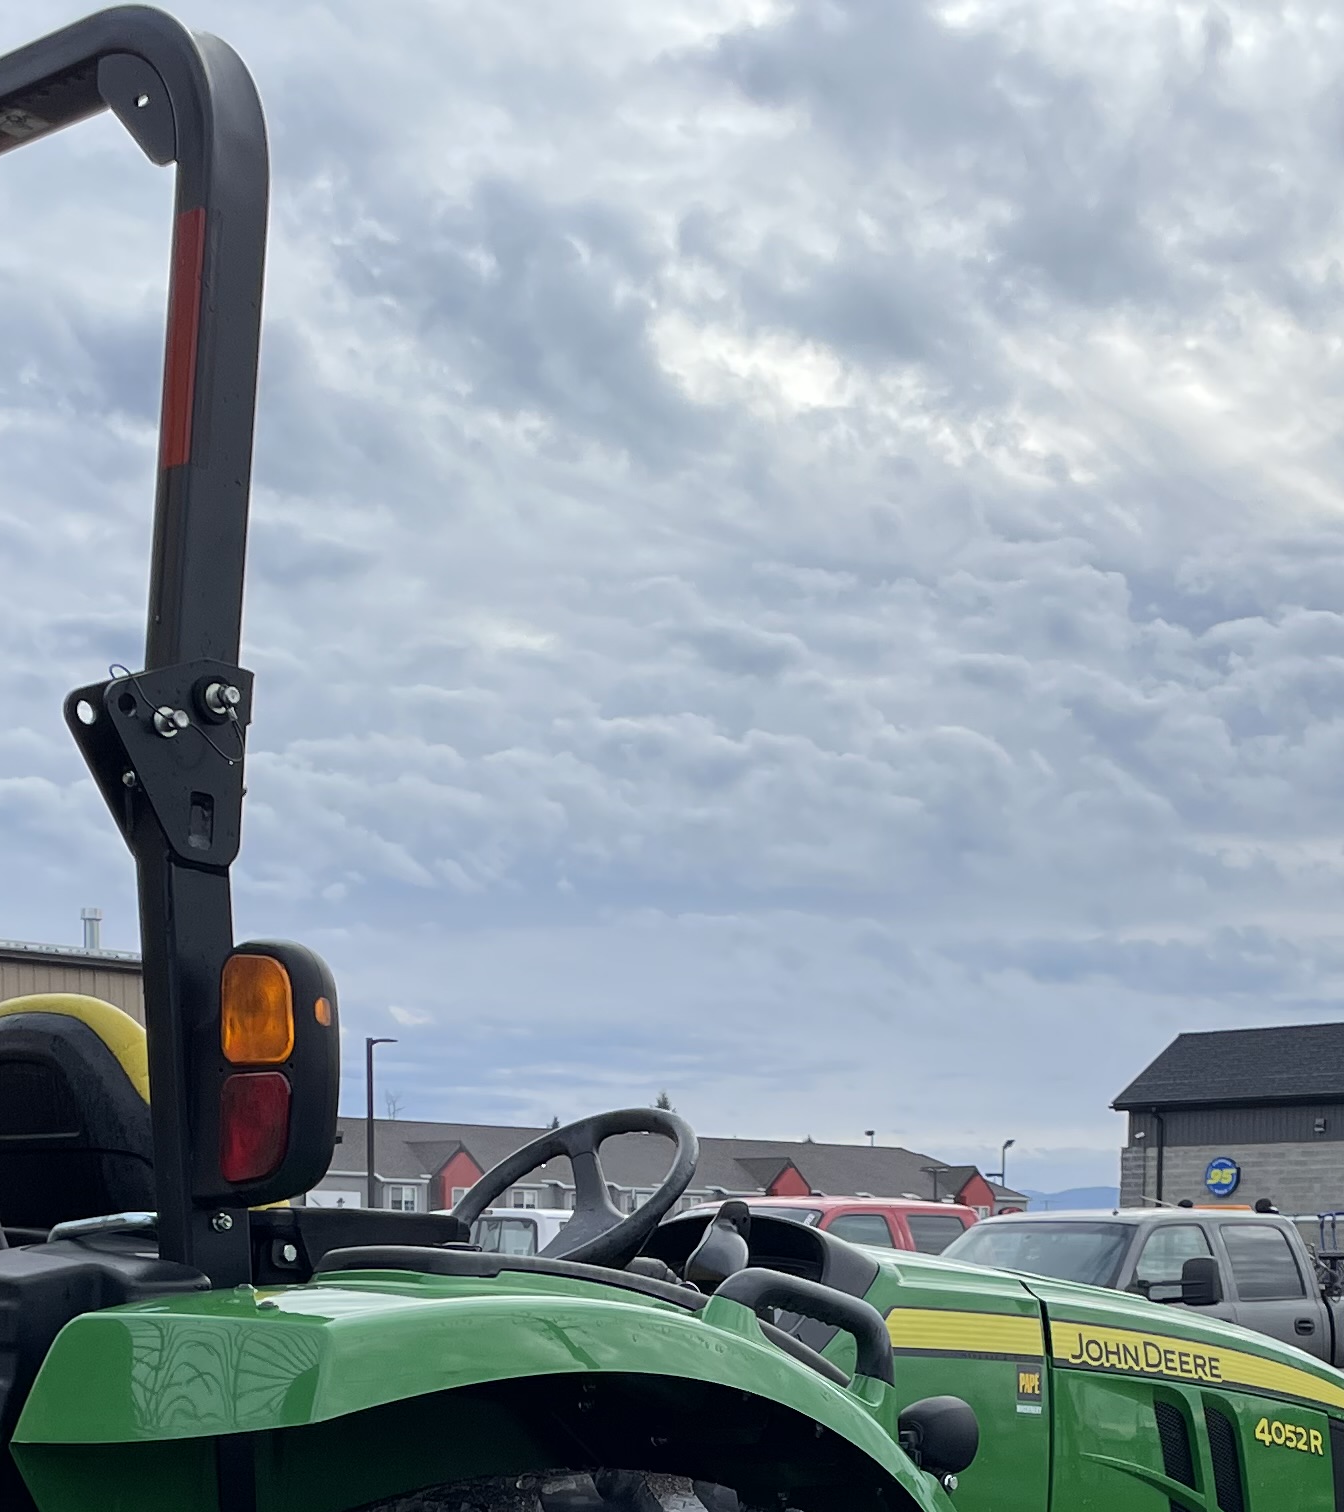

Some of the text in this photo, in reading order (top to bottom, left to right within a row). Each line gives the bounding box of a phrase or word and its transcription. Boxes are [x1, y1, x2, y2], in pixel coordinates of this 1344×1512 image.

[1070, 1332, 1222, 1379] JOHN DEERE
[1255, 1417, 1324, 1456] 4052R
